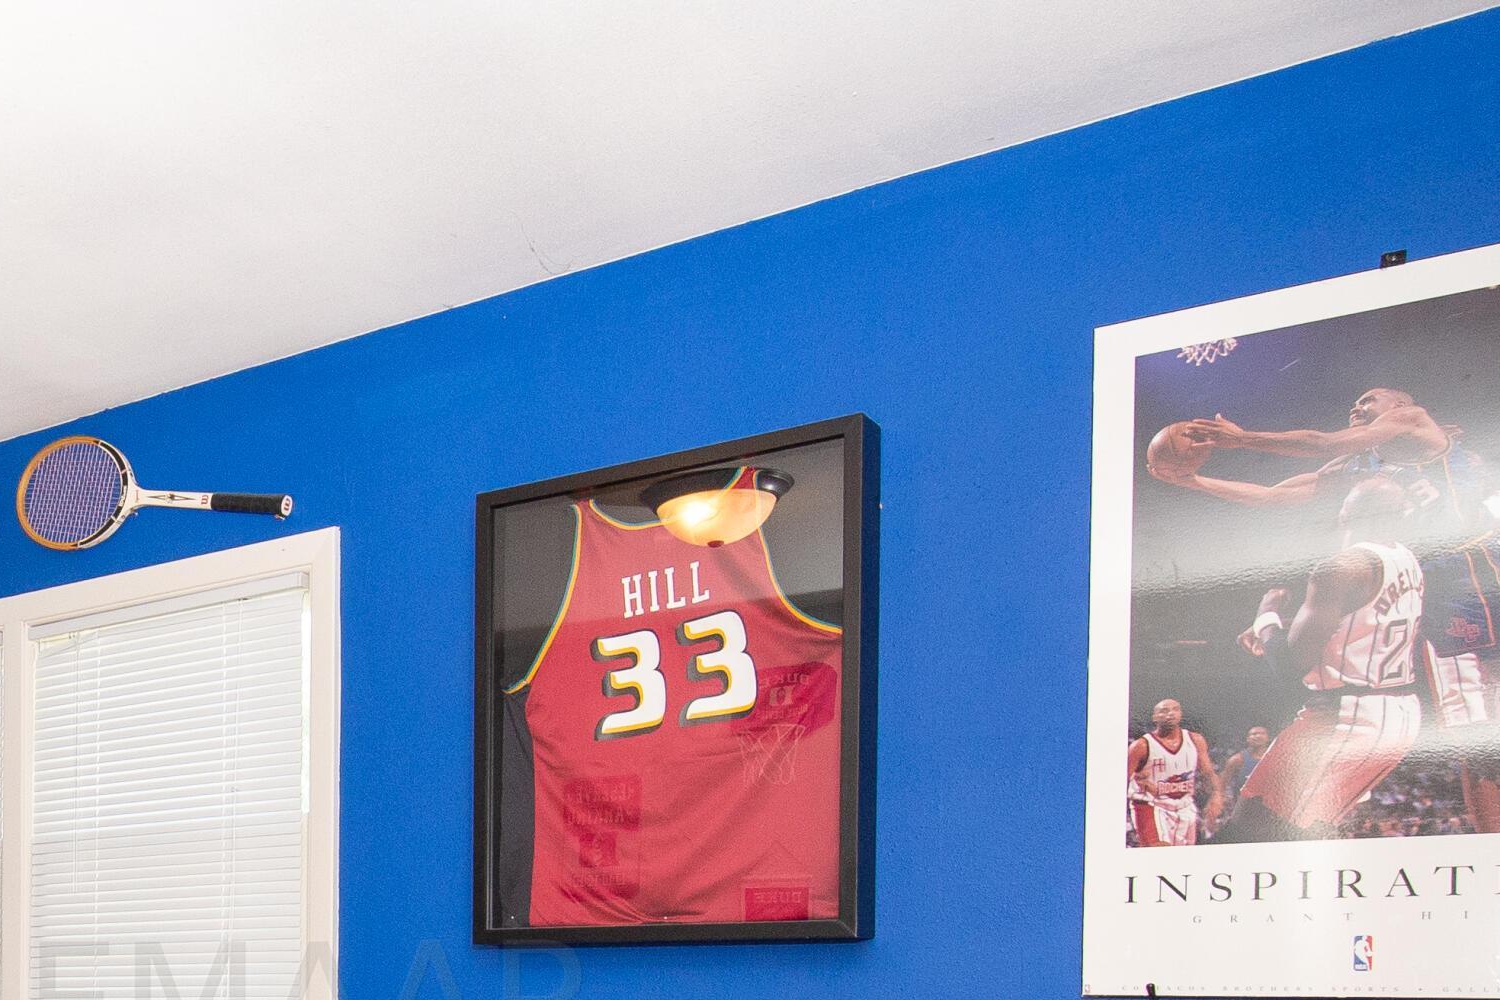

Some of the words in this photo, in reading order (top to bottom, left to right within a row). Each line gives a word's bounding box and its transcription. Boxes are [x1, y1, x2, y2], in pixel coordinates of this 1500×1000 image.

[621, 560, 710, 619] HILL
[592, 610, 757, 741] 33
[1192, 911, 1353, 924] GRANT
